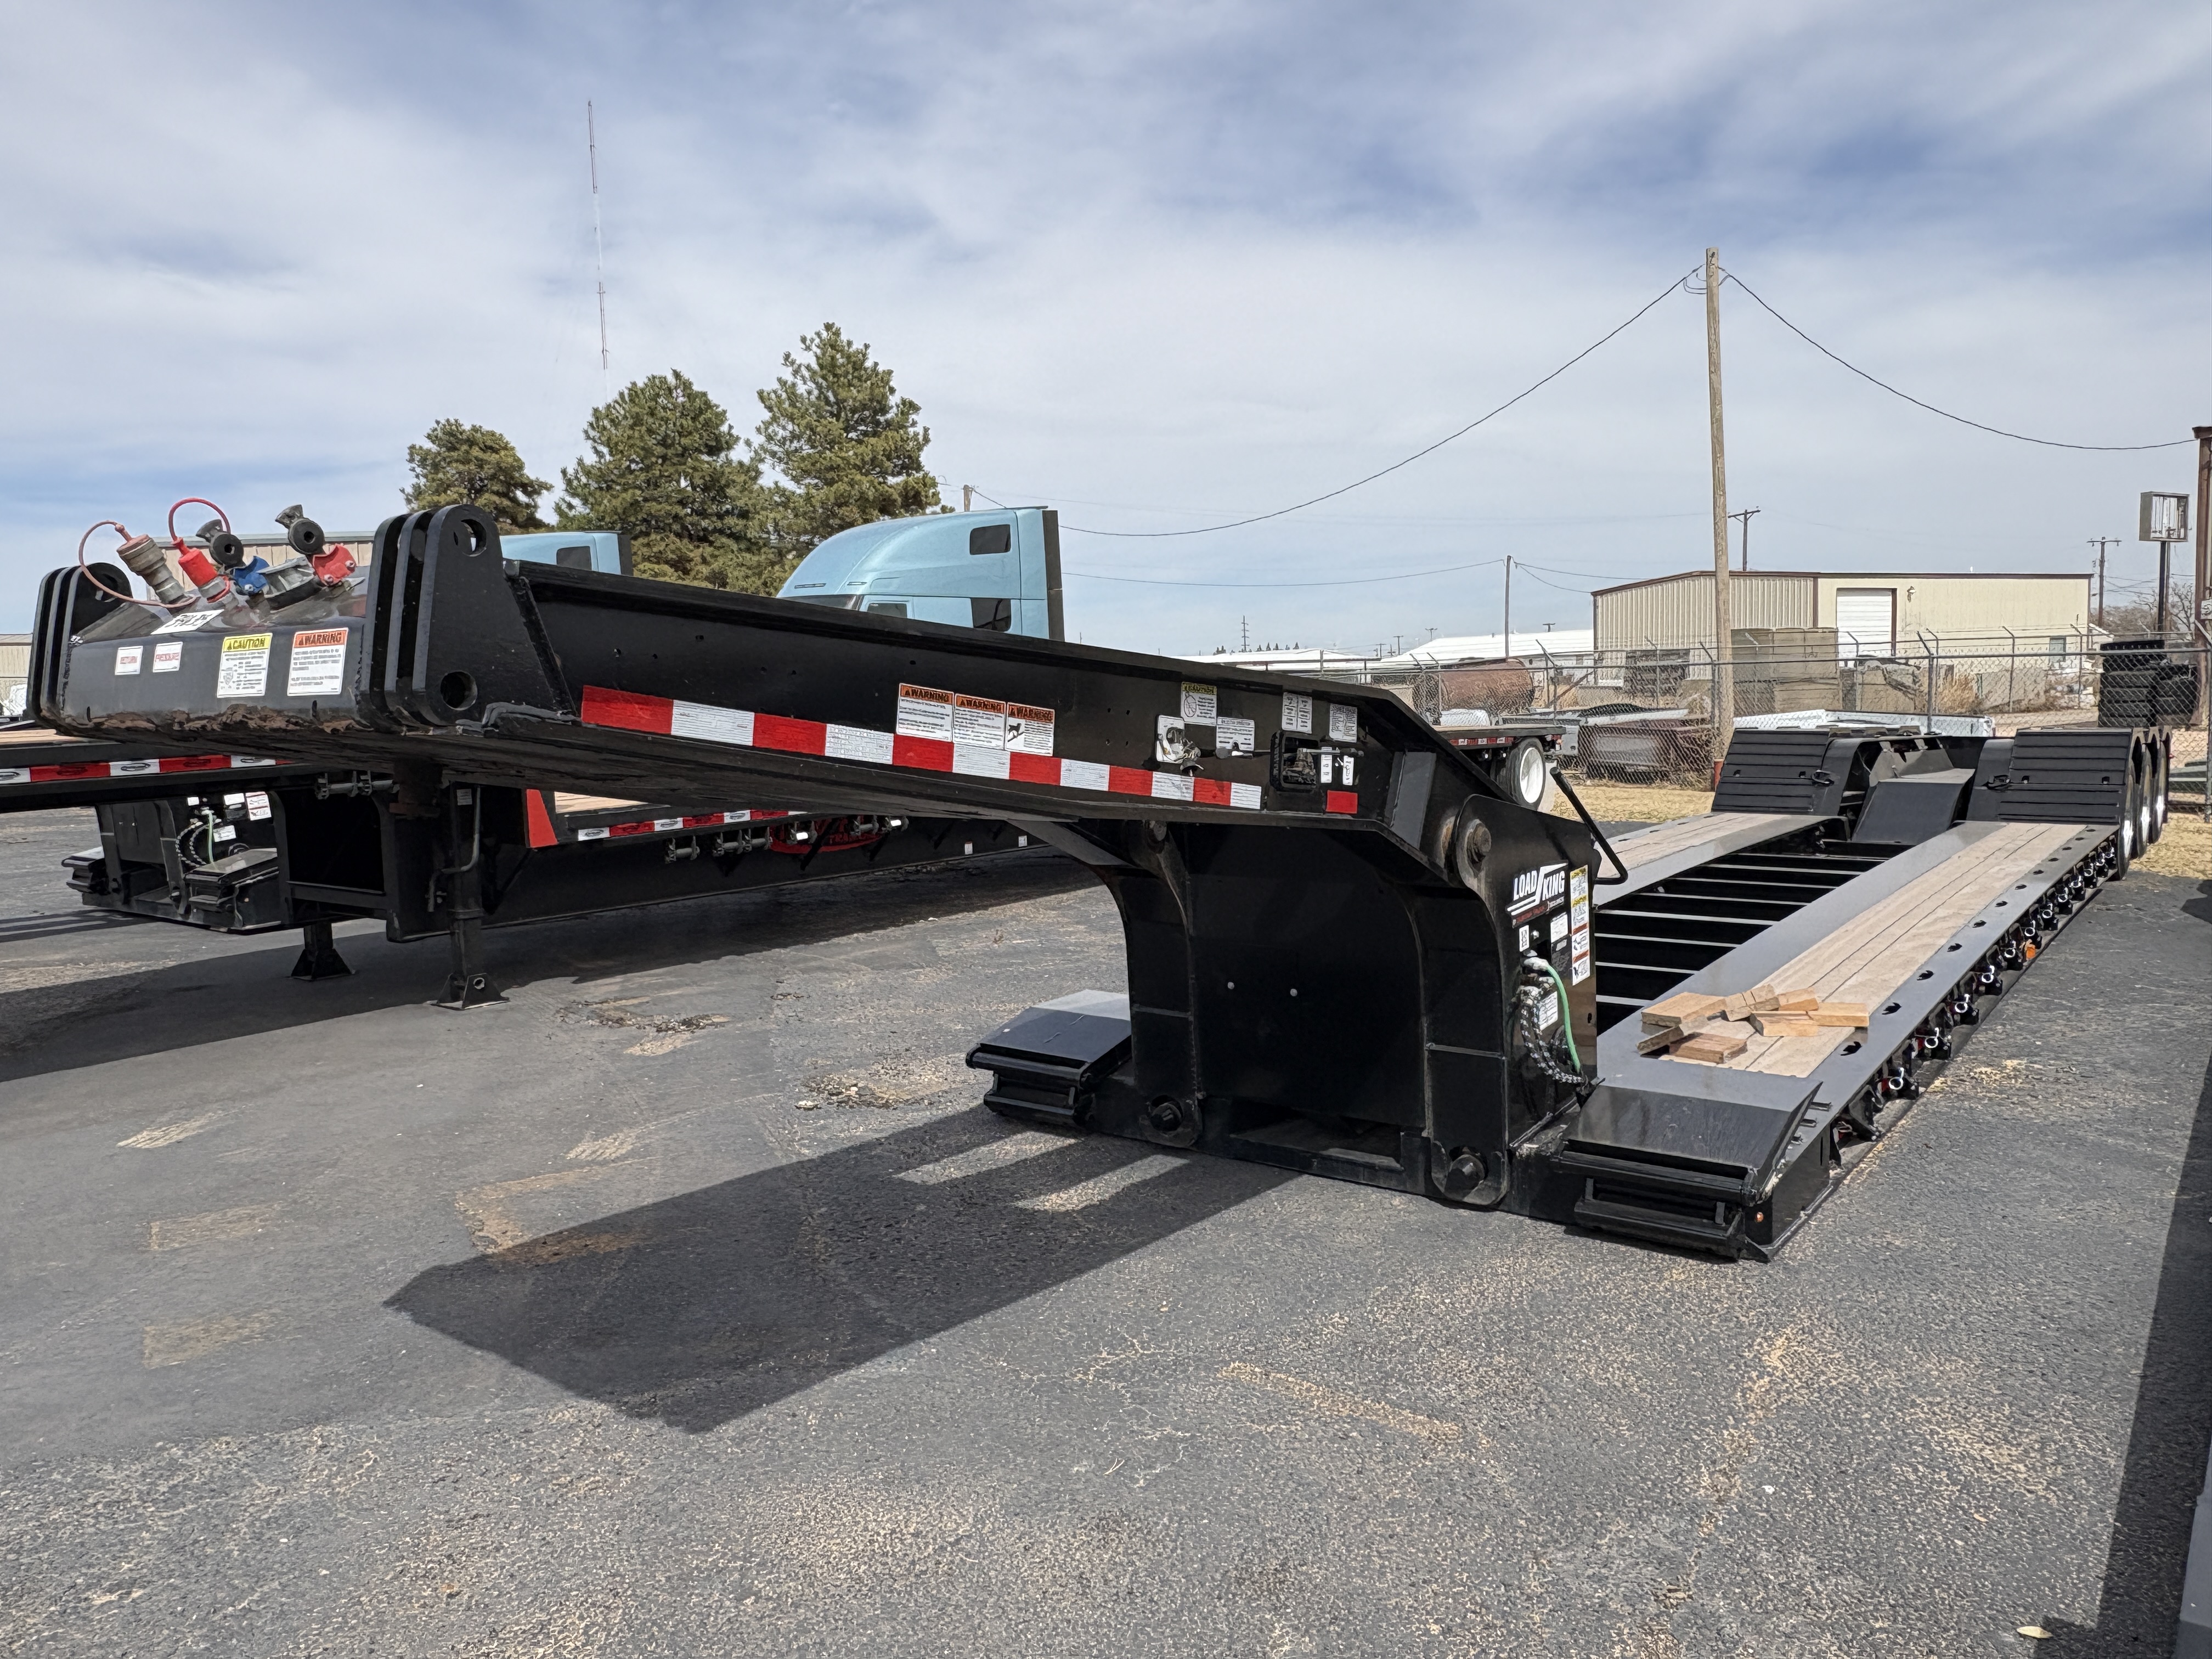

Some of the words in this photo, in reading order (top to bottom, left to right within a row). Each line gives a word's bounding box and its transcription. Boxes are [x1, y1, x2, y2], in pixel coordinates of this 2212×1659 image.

[233, 637, 265, 650] CAUTION
[911, 689, 949, 702] WARNING
[966, 698, 1002, 712] WARNING
[1514, 870, 1538, 901] LOAD
[1542, 871, 1565, 901] KING
